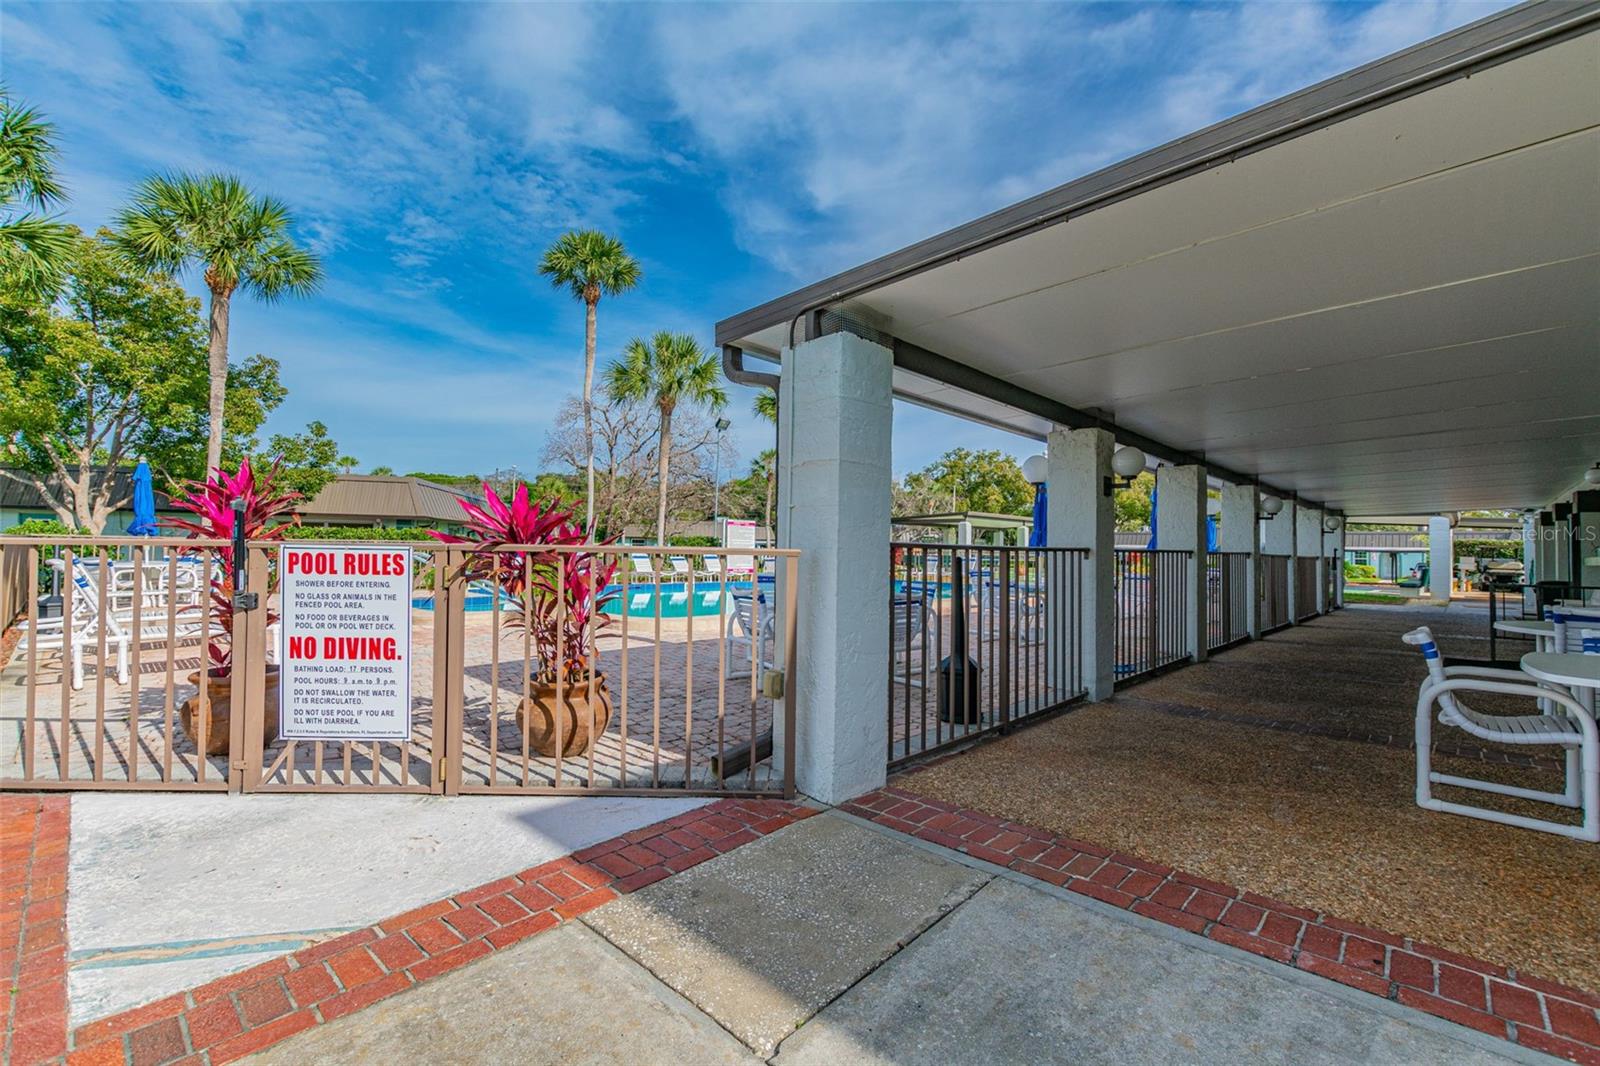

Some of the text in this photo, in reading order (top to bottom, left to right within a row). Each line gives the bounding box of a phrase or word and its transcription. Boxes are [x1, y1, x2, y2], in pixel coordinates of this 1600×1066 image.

[288, 552, 404, 576] POOL RULES
[290, 636, 402, 660] NO DIVING.
